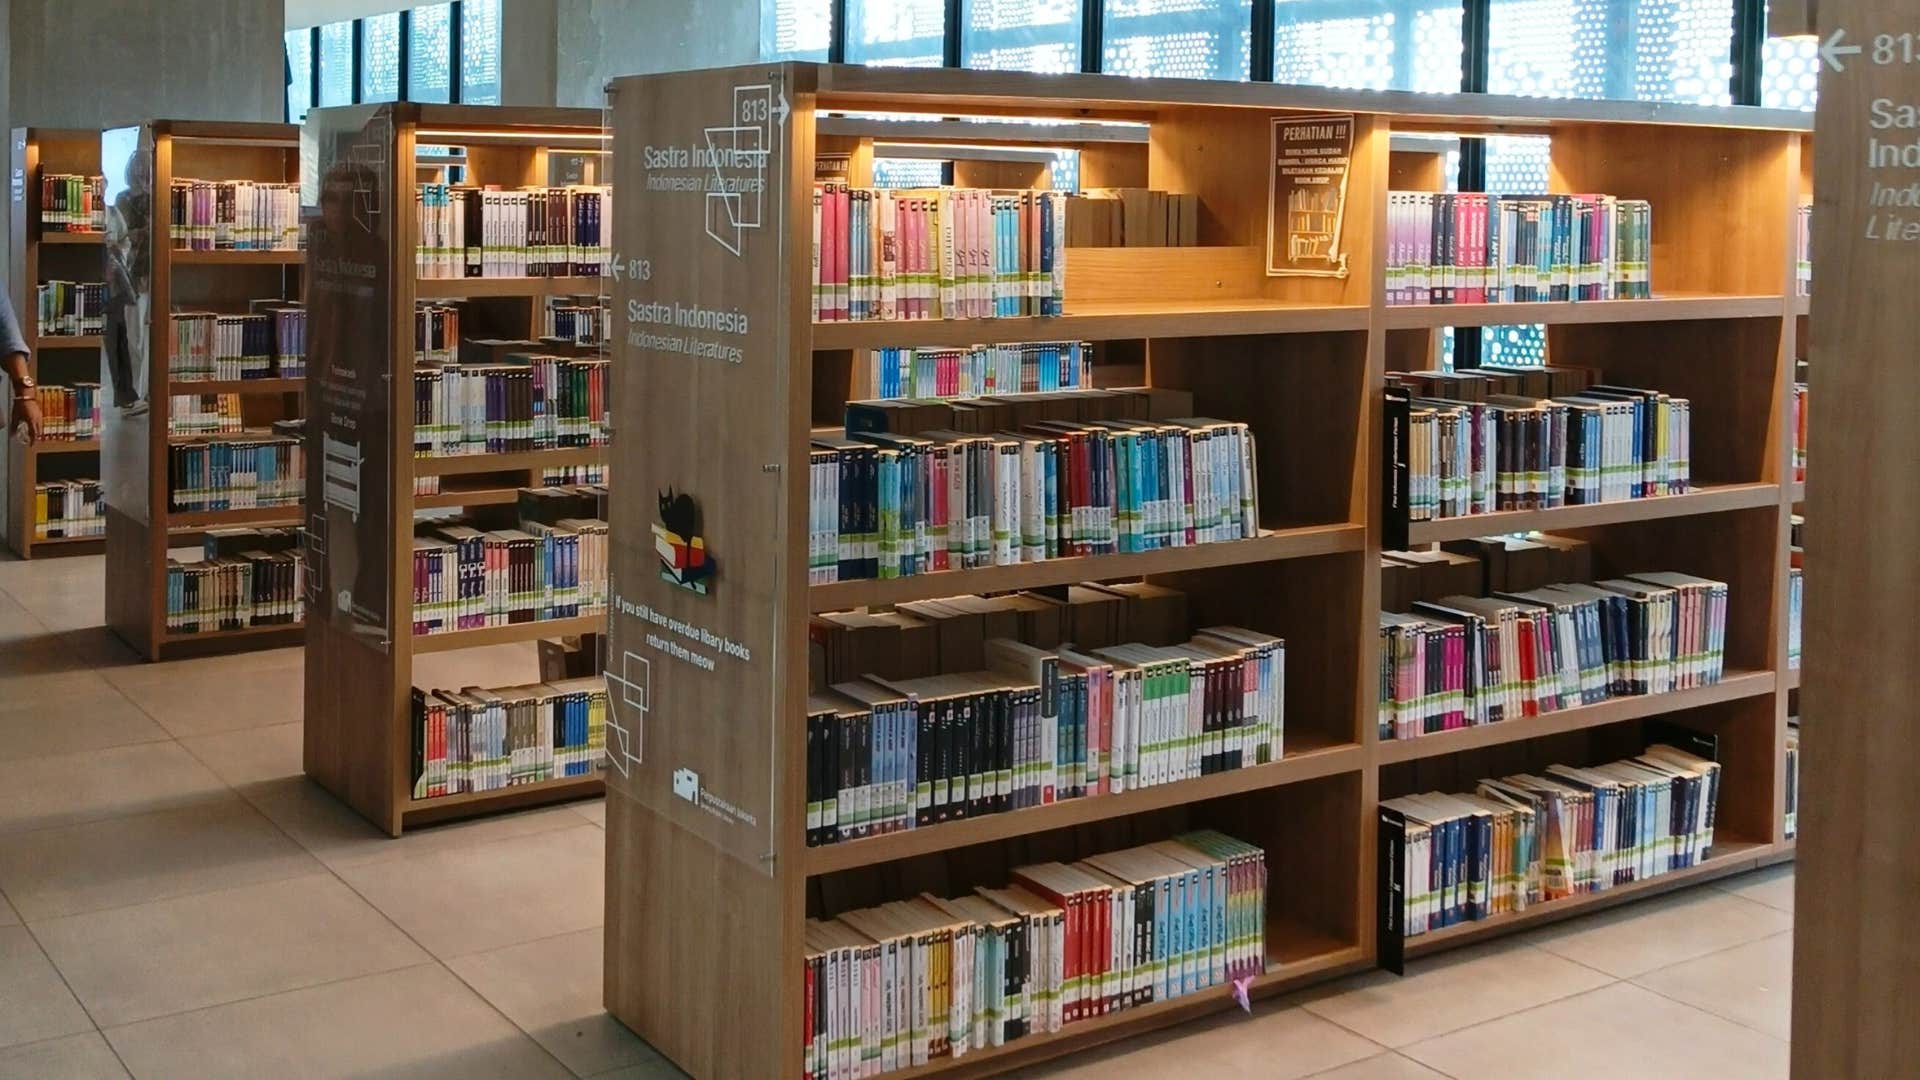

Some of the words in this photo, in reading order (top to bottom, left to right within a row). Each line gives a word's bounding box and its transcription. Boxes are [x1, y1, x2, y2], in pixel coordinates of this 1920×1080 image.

[1872, 33, 1920, 64] 81
[742, 98, 767, 122] 813
[1870, 98, 1920, 129] Sa
[1283, 125, 1334, 141] PERHATIAN
[644, 145, 688, 169] Sastra
[692, 143, 767, 169] Indonesia
[646, 173, 702, 192] Indonesian
[704, 173, 765, 193] Literatures
[629, 259, 650, 281] 813
[628, 299, 671, 324] Sastra
[675, 301, 748, 334] Indonesia
[628, 328, 682, 352] Indonesian
[683, 337, 744, 363] Literatures
[615, 595, 621, 608] If
[621, 600, 635, 613] you
[635, 605, 649, 620] still
[649, 608, 668, 627] have
[668, 618, 700, 640] overdue
[724, 637, 750, 660] books
[646, 633, 669, 652] return
[670, 641, 690, 659] them
[690, 653, 715, 671] meow
